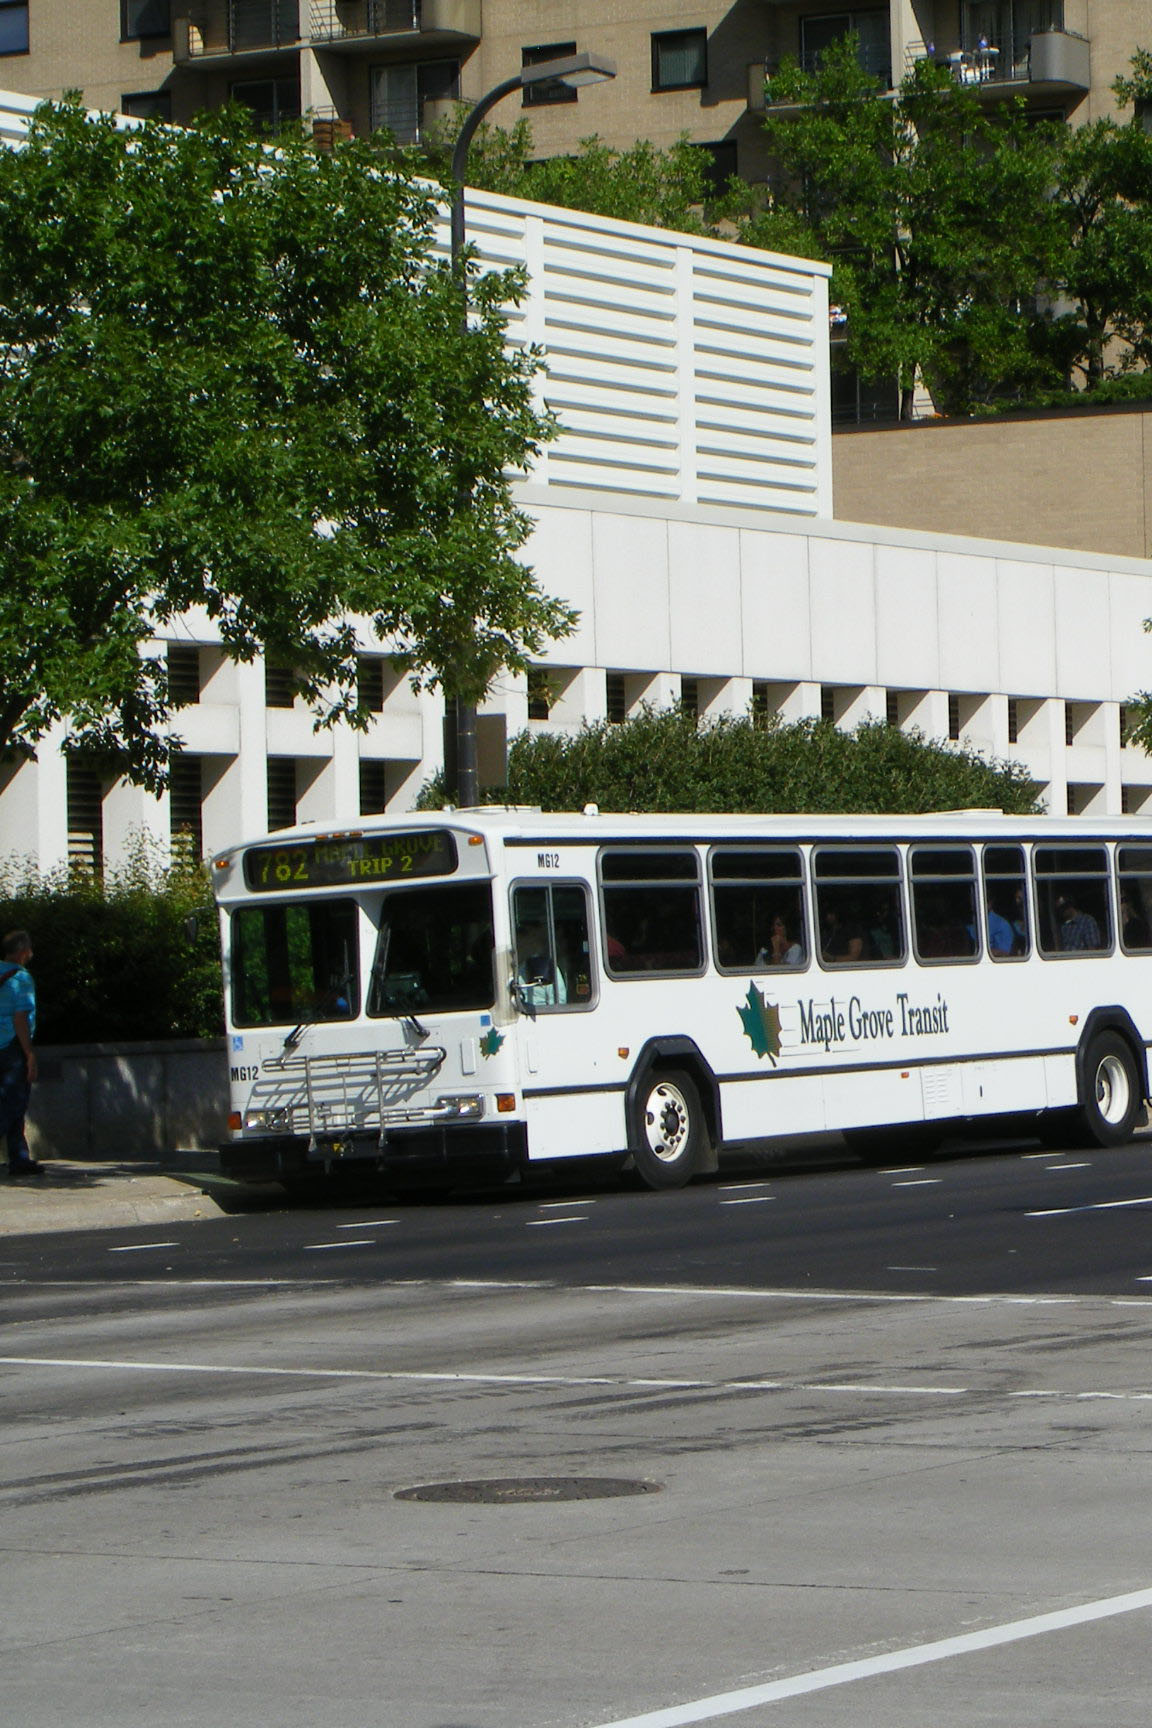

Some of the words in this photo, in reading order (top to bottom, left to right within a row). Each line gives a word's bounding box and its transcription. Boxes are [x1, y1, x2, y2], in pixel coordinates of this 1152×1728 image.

[347, 856, 393, 877] TRIP
[401, 855, 413, 872] 2
[537, 853, 560, 869] MG12
[797, 995, 846, 1053] Maple
[849, 996, 895, 1041] Grove
[896, 993, 949, 1037] Transit
[231, 1065, 259, 1082] MG12
